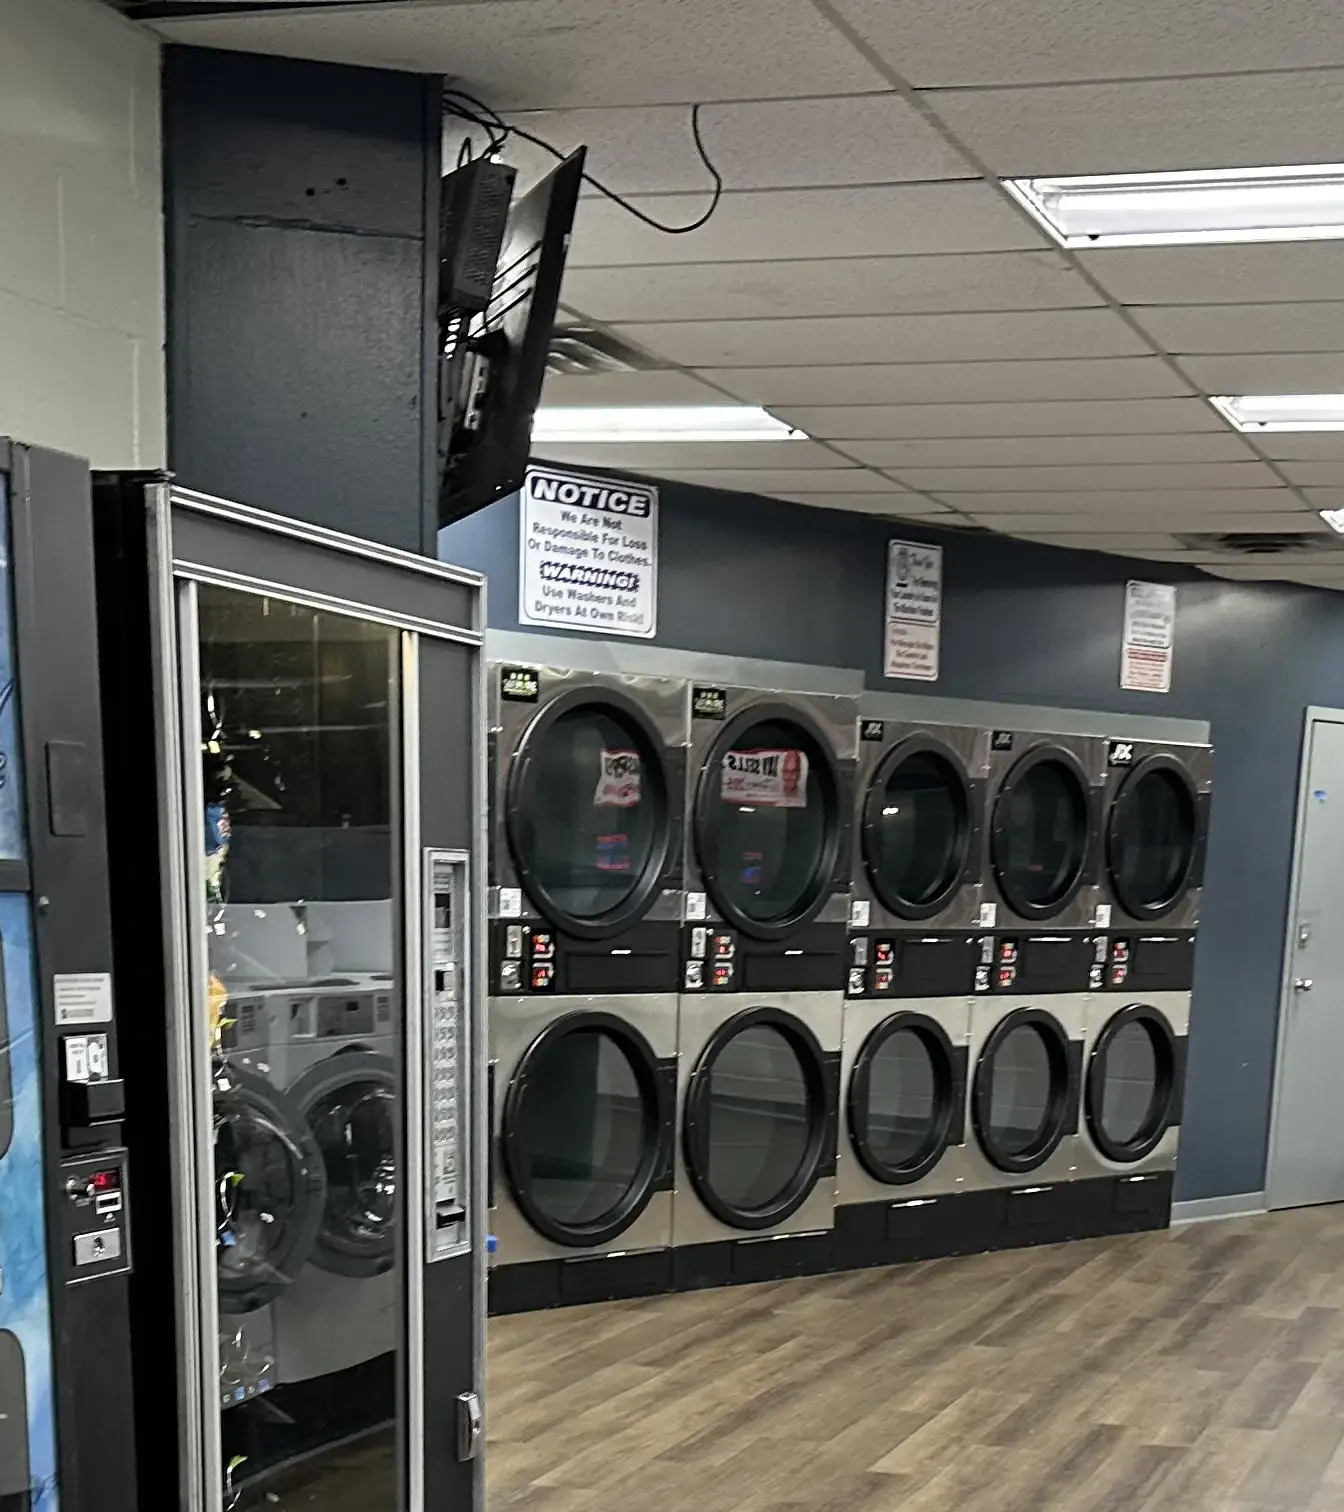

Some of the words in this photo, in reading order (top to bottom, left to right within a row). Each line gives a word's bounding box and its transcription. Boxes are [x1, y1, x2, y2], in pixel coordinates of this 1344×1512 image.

[533, 478, 648, 516] NOTICE
[560, 510, 577, 523] We
[580, 513, 599, 527] Are
[601, 516, 622, 530] Not
[533, 521, 599, 543] Responsible
[602, 532, 620, 545] For
[622, 536, 648, 550] Loss
[528, 538, 541, 550] Or
[544, 540, 589, 559] Damage
[591, 548, 605, 560] To
[542, 564, 636, 589] WARNING!
[542, 585, 563, 598] Use
[567, 588, 613, 605] Washers
[616, 595, 637, 607] And
[535, 600, 572, 616] Dryers
[575, 605, 587, 617] At
[590, 608, 614, 620] Own
